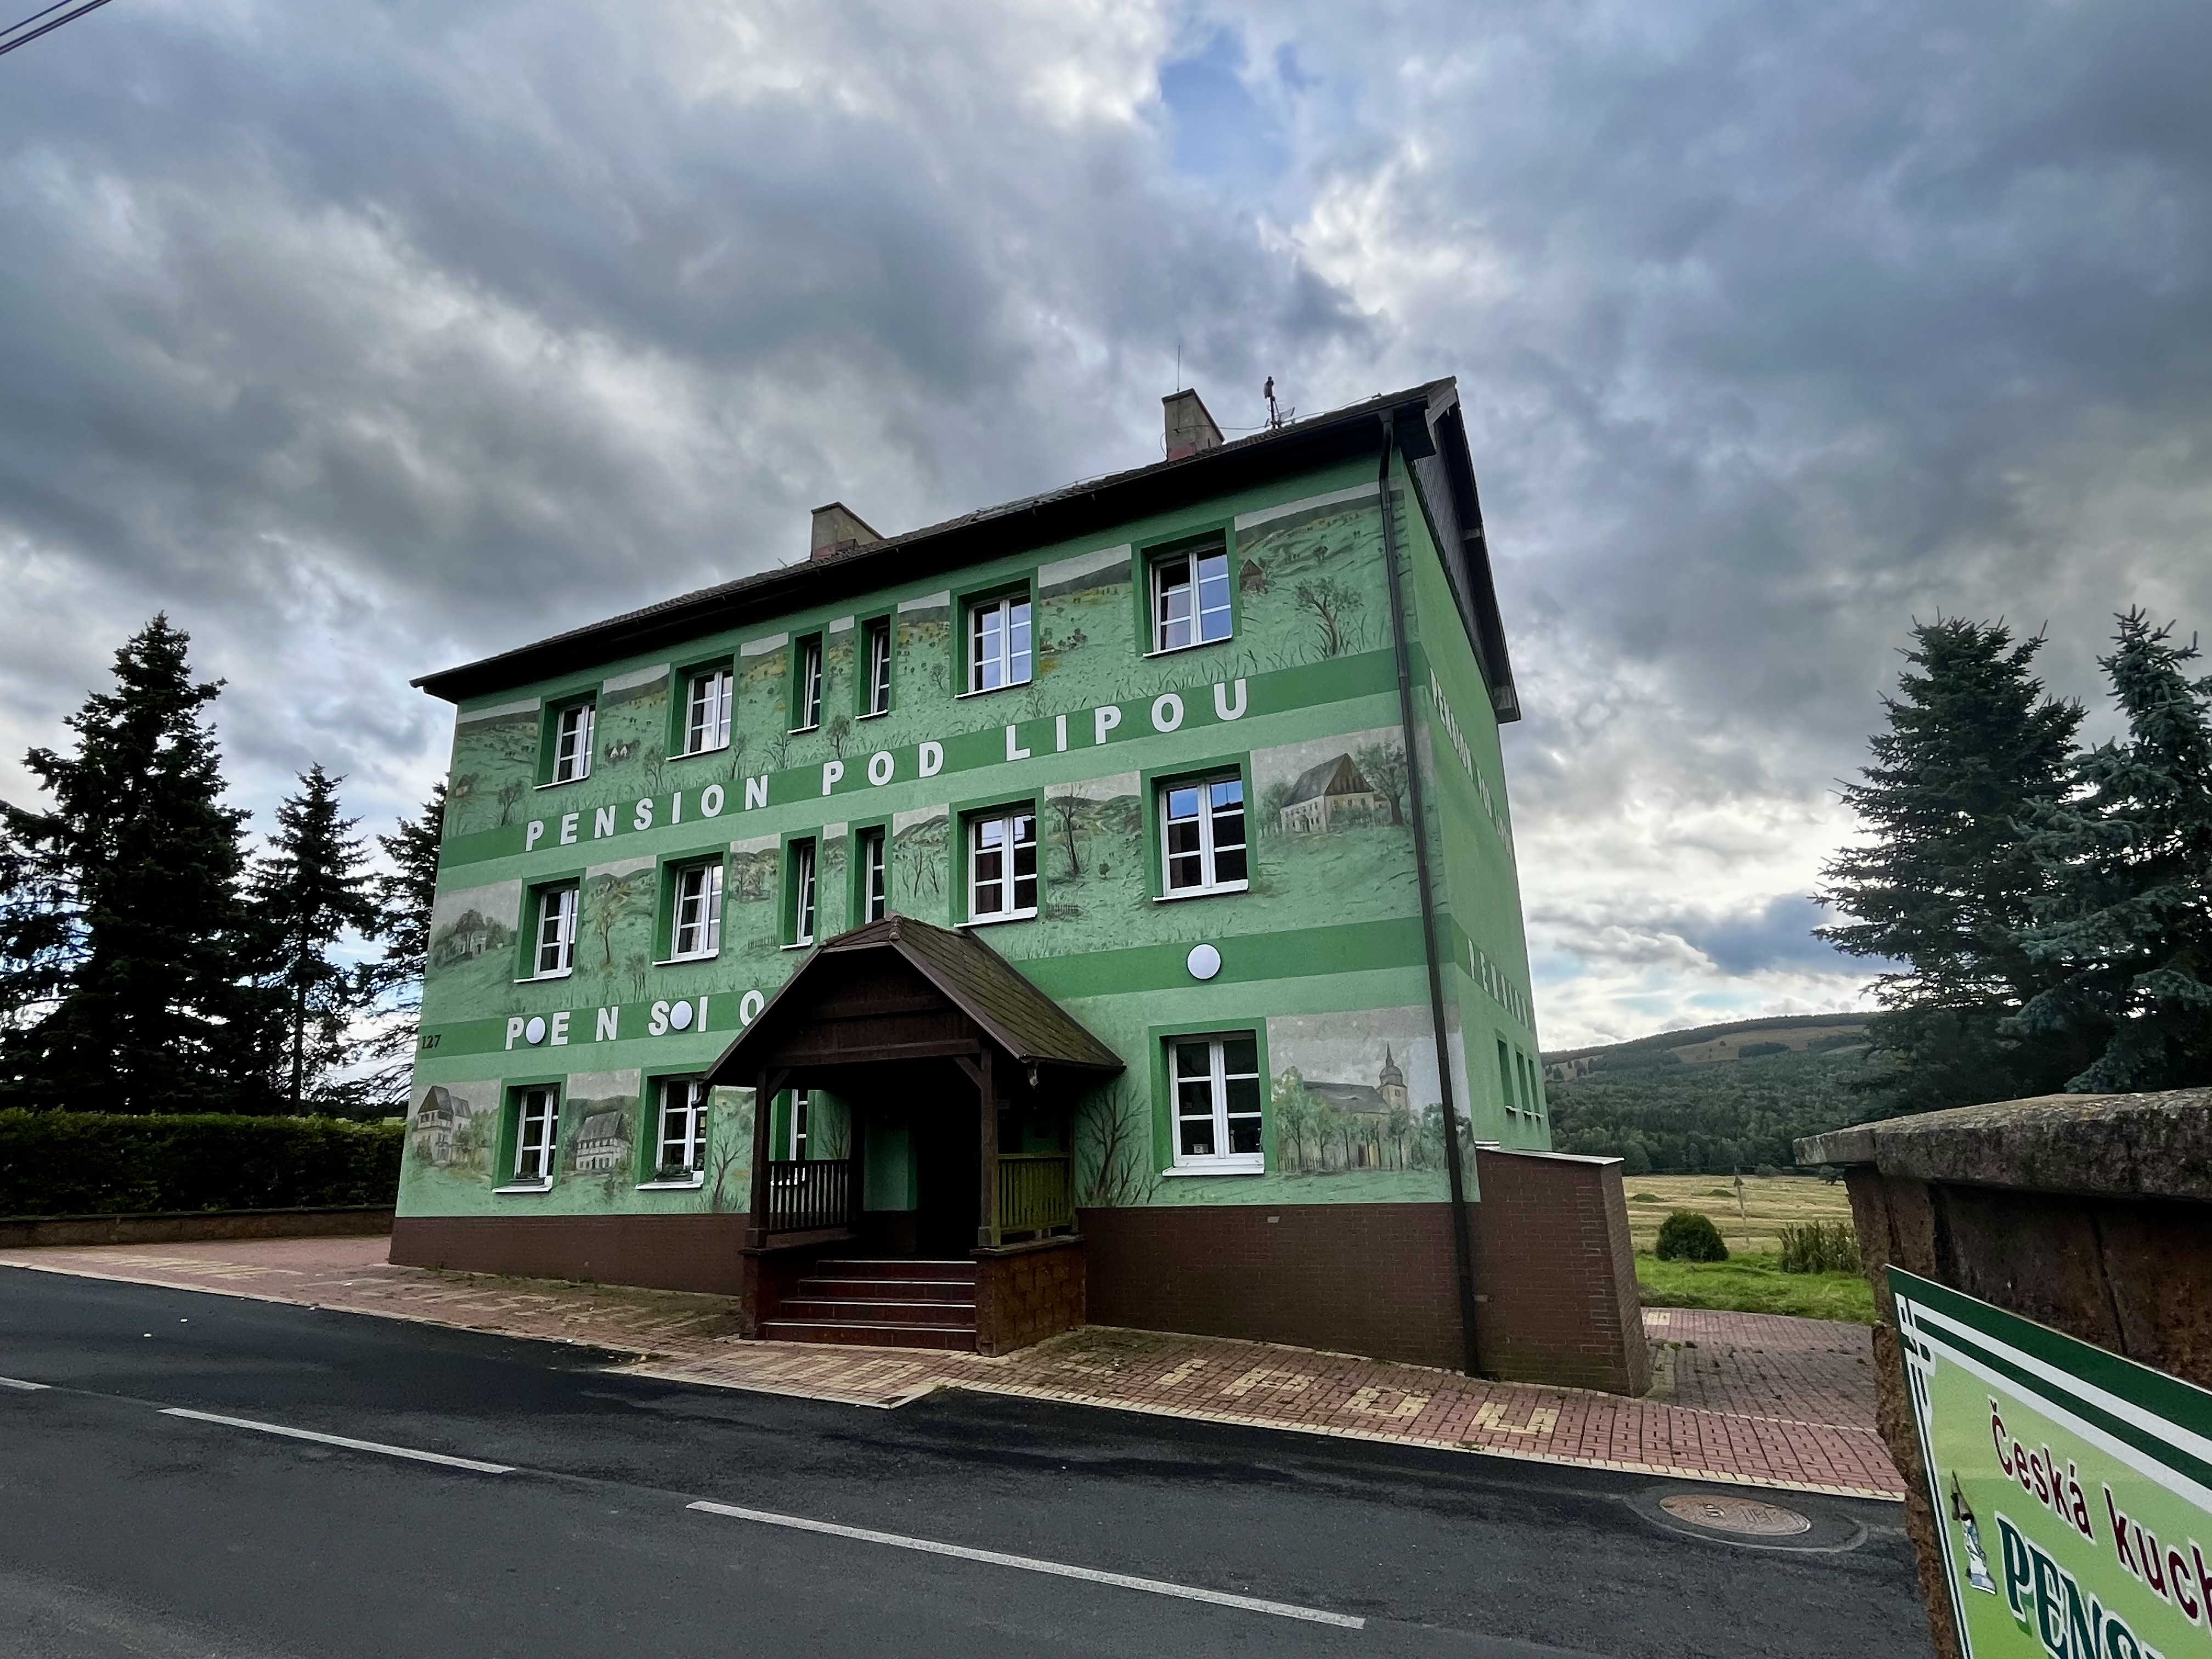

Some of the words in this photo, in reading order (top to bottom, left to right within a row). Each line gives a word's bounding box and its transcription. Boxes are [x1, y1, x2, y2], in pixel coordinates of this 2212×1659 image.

[525, 774, 769, 851] PENSION
[822, 741, 944, 796] POD
[1006, 678, 1248, 762] LIPOU
[421, 1034, 442, 1049] 127
[1989, 1398, 2094, 1539] Česká
